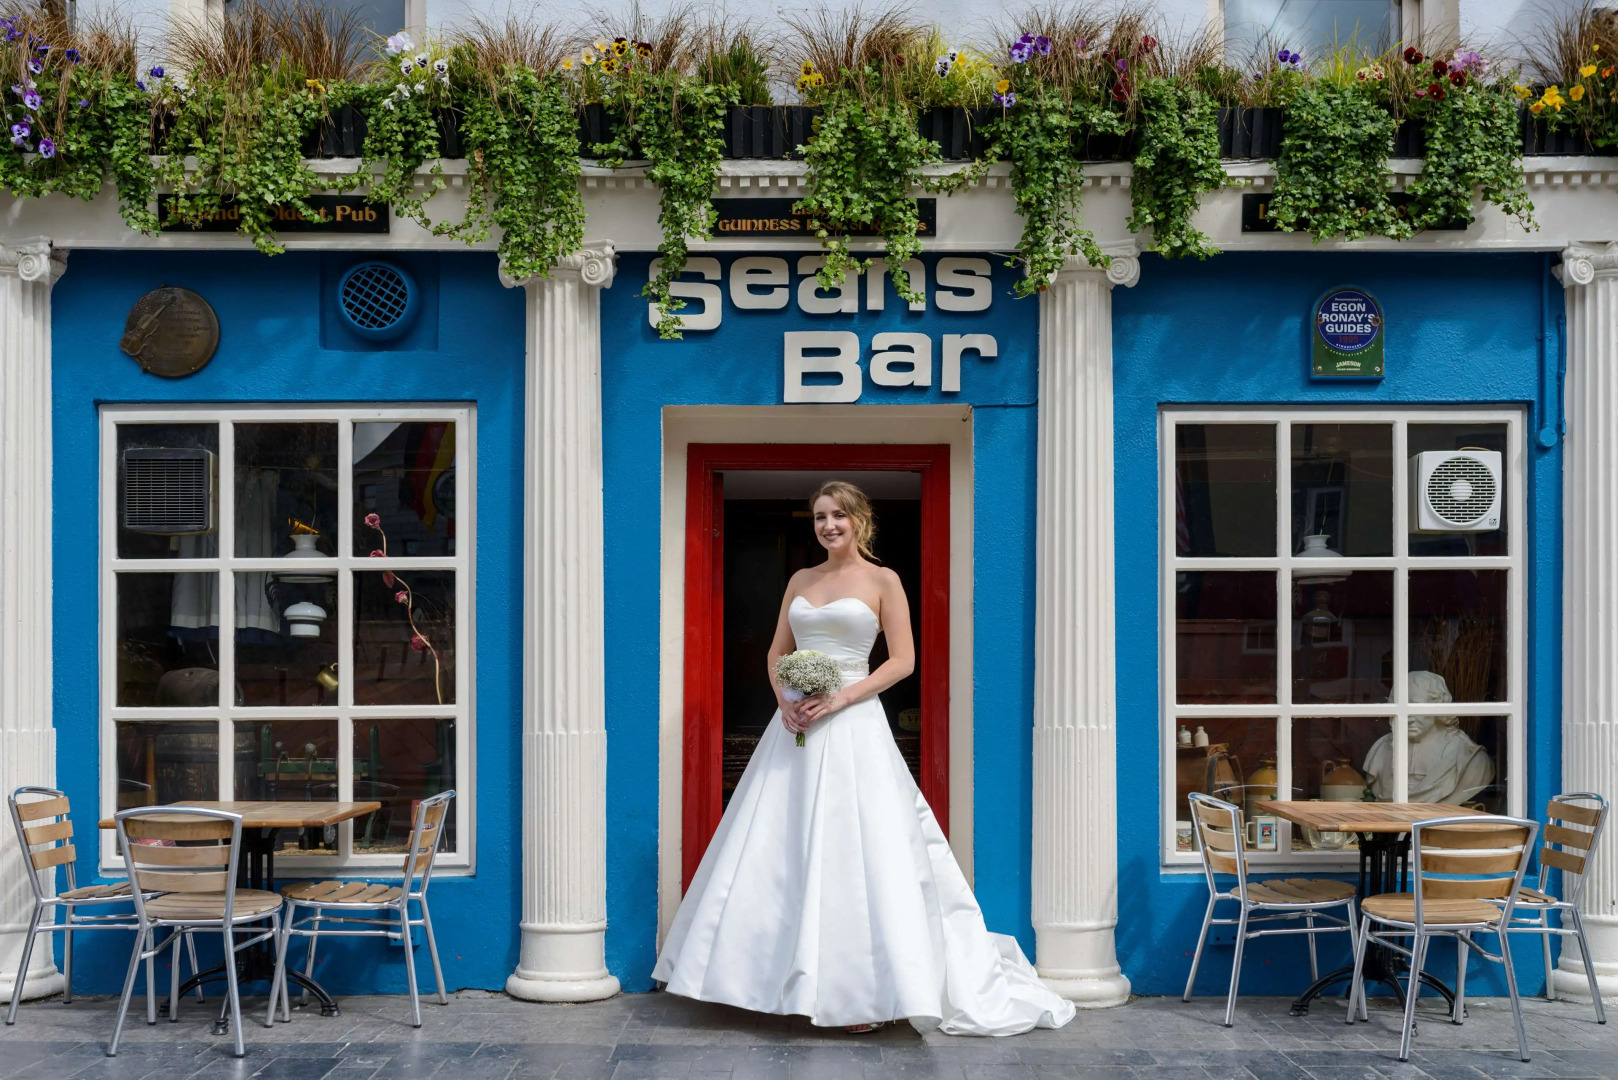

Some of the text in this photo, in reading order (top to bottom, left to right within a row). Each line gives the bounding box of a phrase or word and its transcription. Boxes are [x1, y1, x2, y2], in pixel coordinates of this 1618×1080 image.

[335, 205, 377, 221] Pub
[718, 218, 801, 231] GUINNESS
[648, 255, 992, 331] Seans
[1331, 303, 1366, 312] EGON
[1322, 313, 1375, 322] RONAY'S
[1325, 323, 1372, 333] GUIDES
[783, 330, 998, 404] Bar
[1335, 360, 1362, 368] JAMESON
